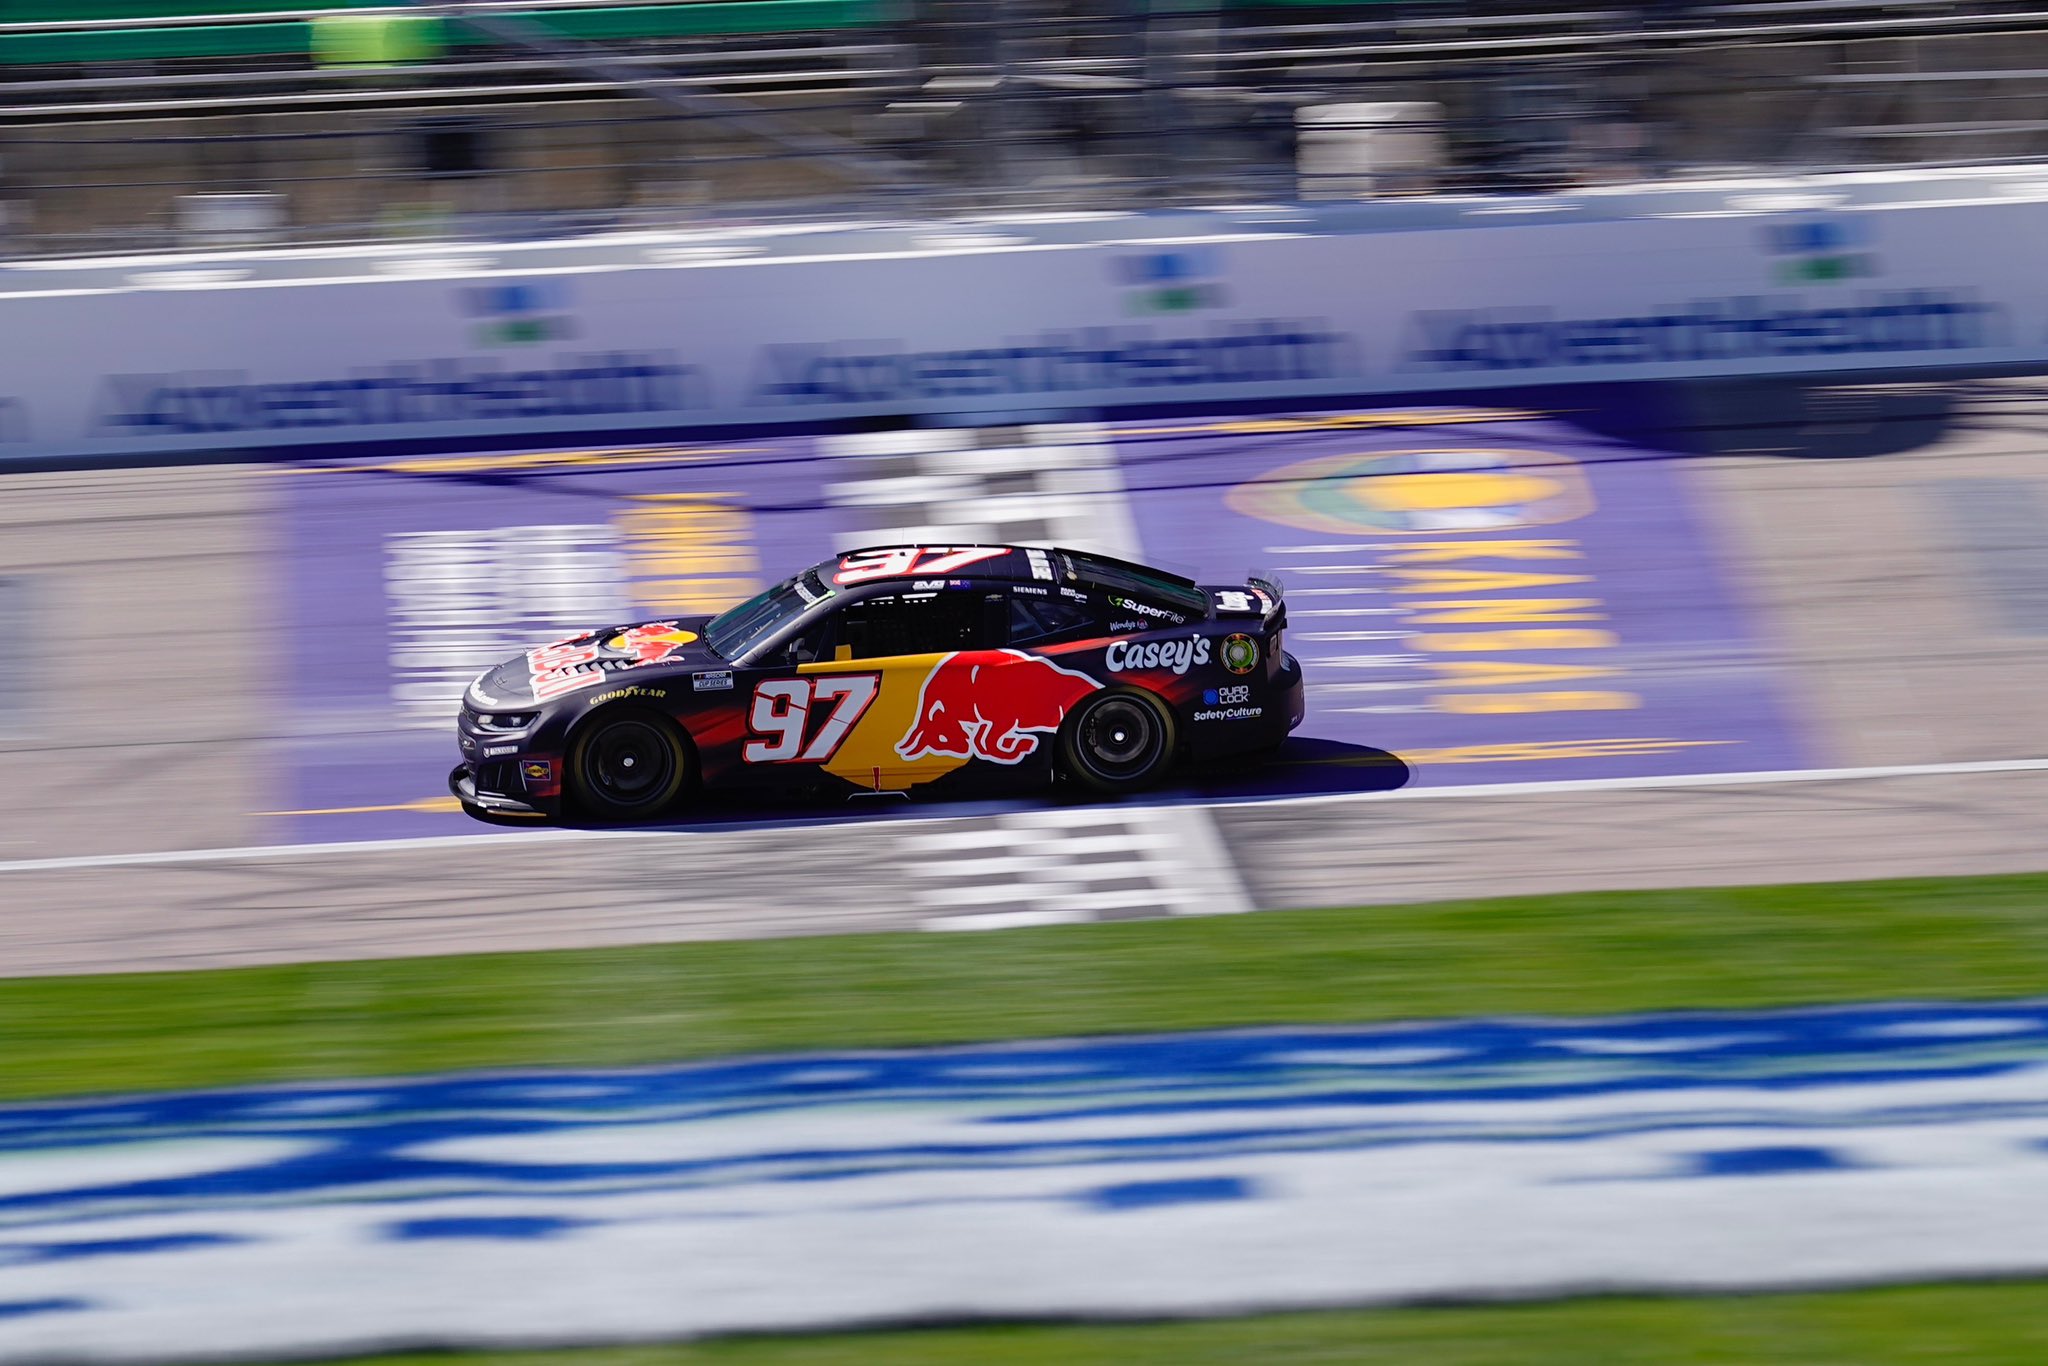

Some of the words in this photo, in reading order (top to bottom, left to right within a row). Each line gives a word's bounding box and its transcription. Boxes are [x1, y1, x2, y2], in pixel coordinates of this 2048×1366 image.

[1013, 586, 1048, 596] SIEMENS
[1122, 598, 1184, 624] SuperFile
[1105, 634, 1211, 675] Casey's
[1218, 685, 1249, 697] QUAD
[1219, 693, 1249, 704] LOCK
[742, 669, 882, 764] 97
[1193, 707, 1262, 721] SafetyCulture
